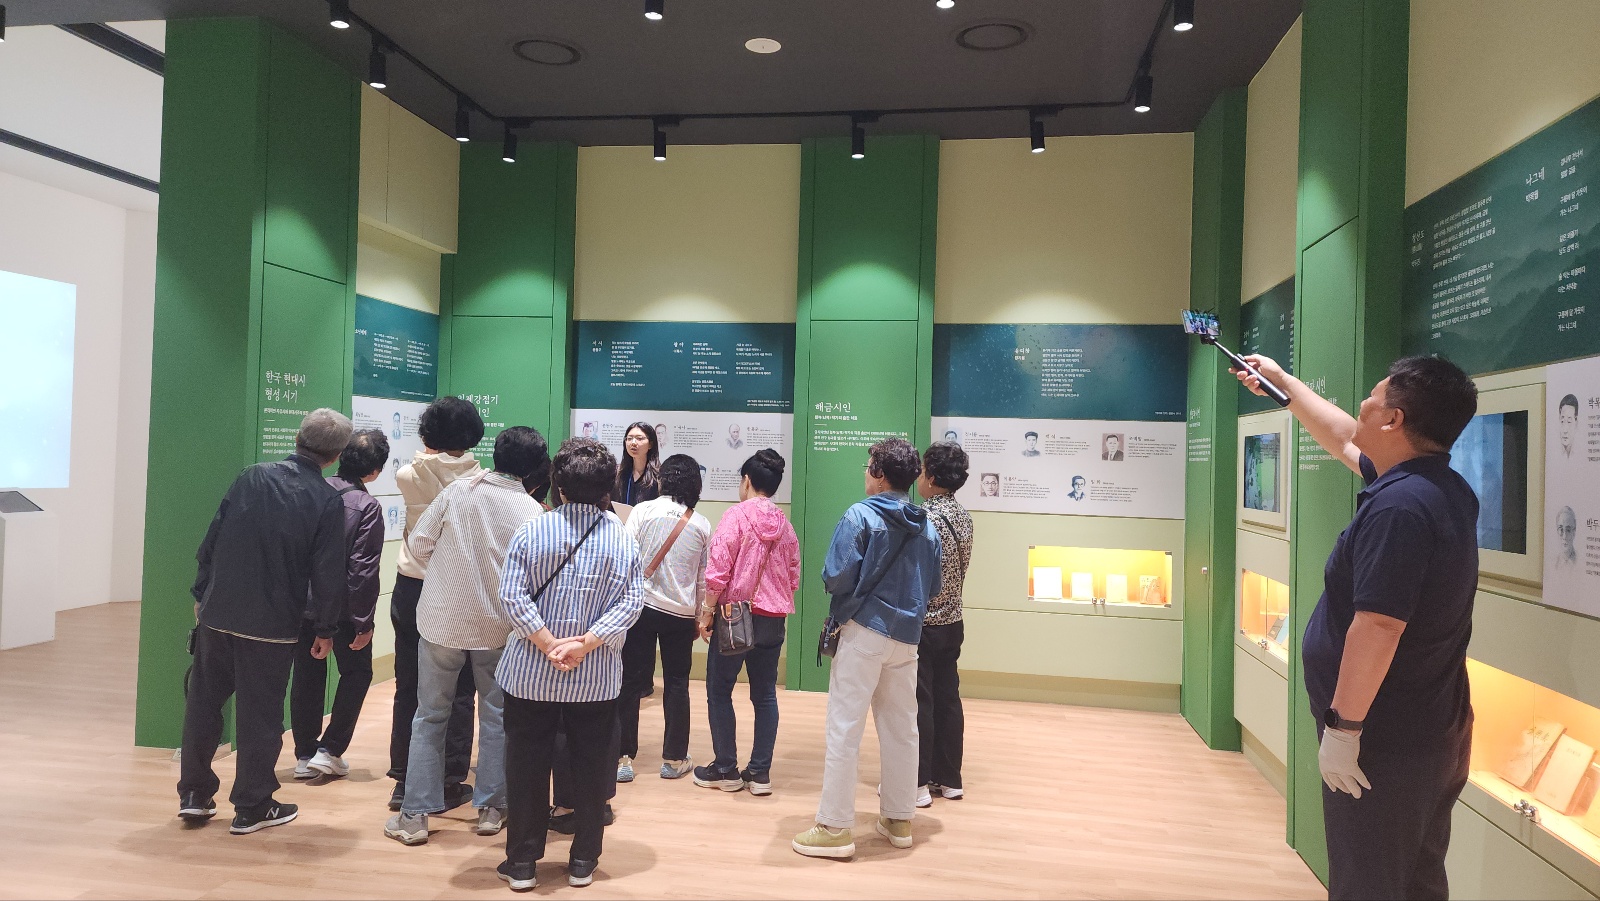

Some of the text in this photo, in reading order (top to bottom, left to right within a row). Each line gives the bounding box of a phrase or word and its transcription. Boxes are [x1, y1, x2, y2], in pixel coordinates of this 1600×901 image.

[1525, 166, 1545, 186] 나그네
[265, 369, 306, 388] 한국 현대시
[264, 387, 298, 404] 형성 시기
[814, 401, 852, 413] 해금시인
